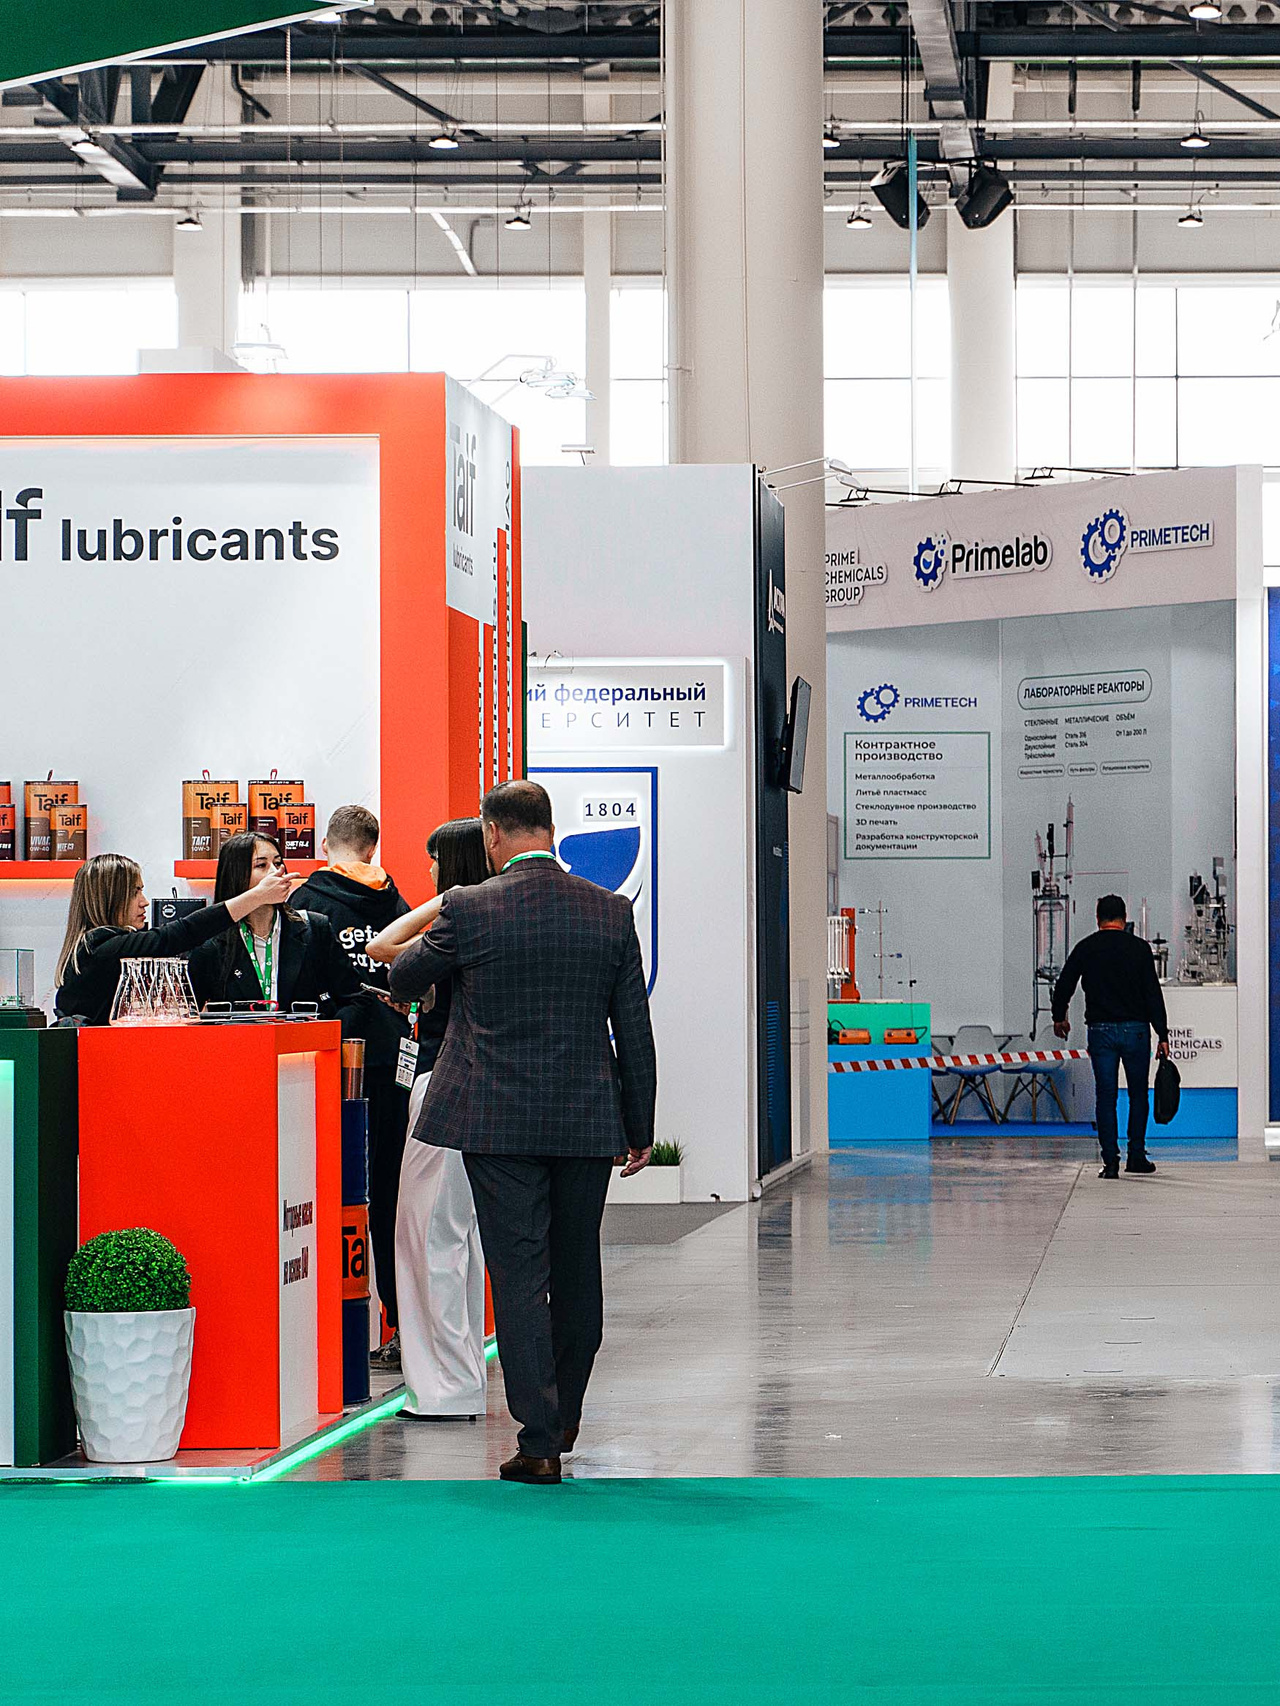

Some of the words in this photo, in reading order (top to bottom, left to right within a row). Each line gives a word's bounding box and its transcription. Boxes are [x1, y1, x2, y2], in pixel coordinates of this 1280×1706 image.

[61, 516, 340, 561] lubricants
[1130, 523, 1210, 548] PRIMETECH
[951, 534, 1048, 574] Primelab
[554, 683, 706, 706] федеральный
[1023, 683, 1095, 699] ЛАБОРАТОРНЫЕ
[1097, 680, 1145, 694] РЕАКТОРЫ
[904, 697, 978, 708] PRIMETECH
[541, 712, 706, 728] ЕРСИТЕТ
[1065, 714, 1109, 724] МЕТАЛЛИЧЕСКИЕ
[855, 740, 936, 751] Контрактное
[855, 751, 943, 762] производство
[855, 773, 935, 782] Металлообработка
[585, 803, 636, 817] 1804
[855, 803, 915, 811] Стеклодувное
[917, 803, 977, 811] производство
[58, 814, 82, 826] Taif
[220, 813, 243, 825] Taif
[285, 813, 308, 825] Taif
[856, 833, 904, 841] Разработка
[906, 833, 979, 841] конструкторской
[855, 843, 918, 851] документации
[1168, 1029, 1193, 1038] RIME
[1169, 1040, 1222, 1049] HEMICALS
[1169, 1051, 1198, 1060] ROUP
